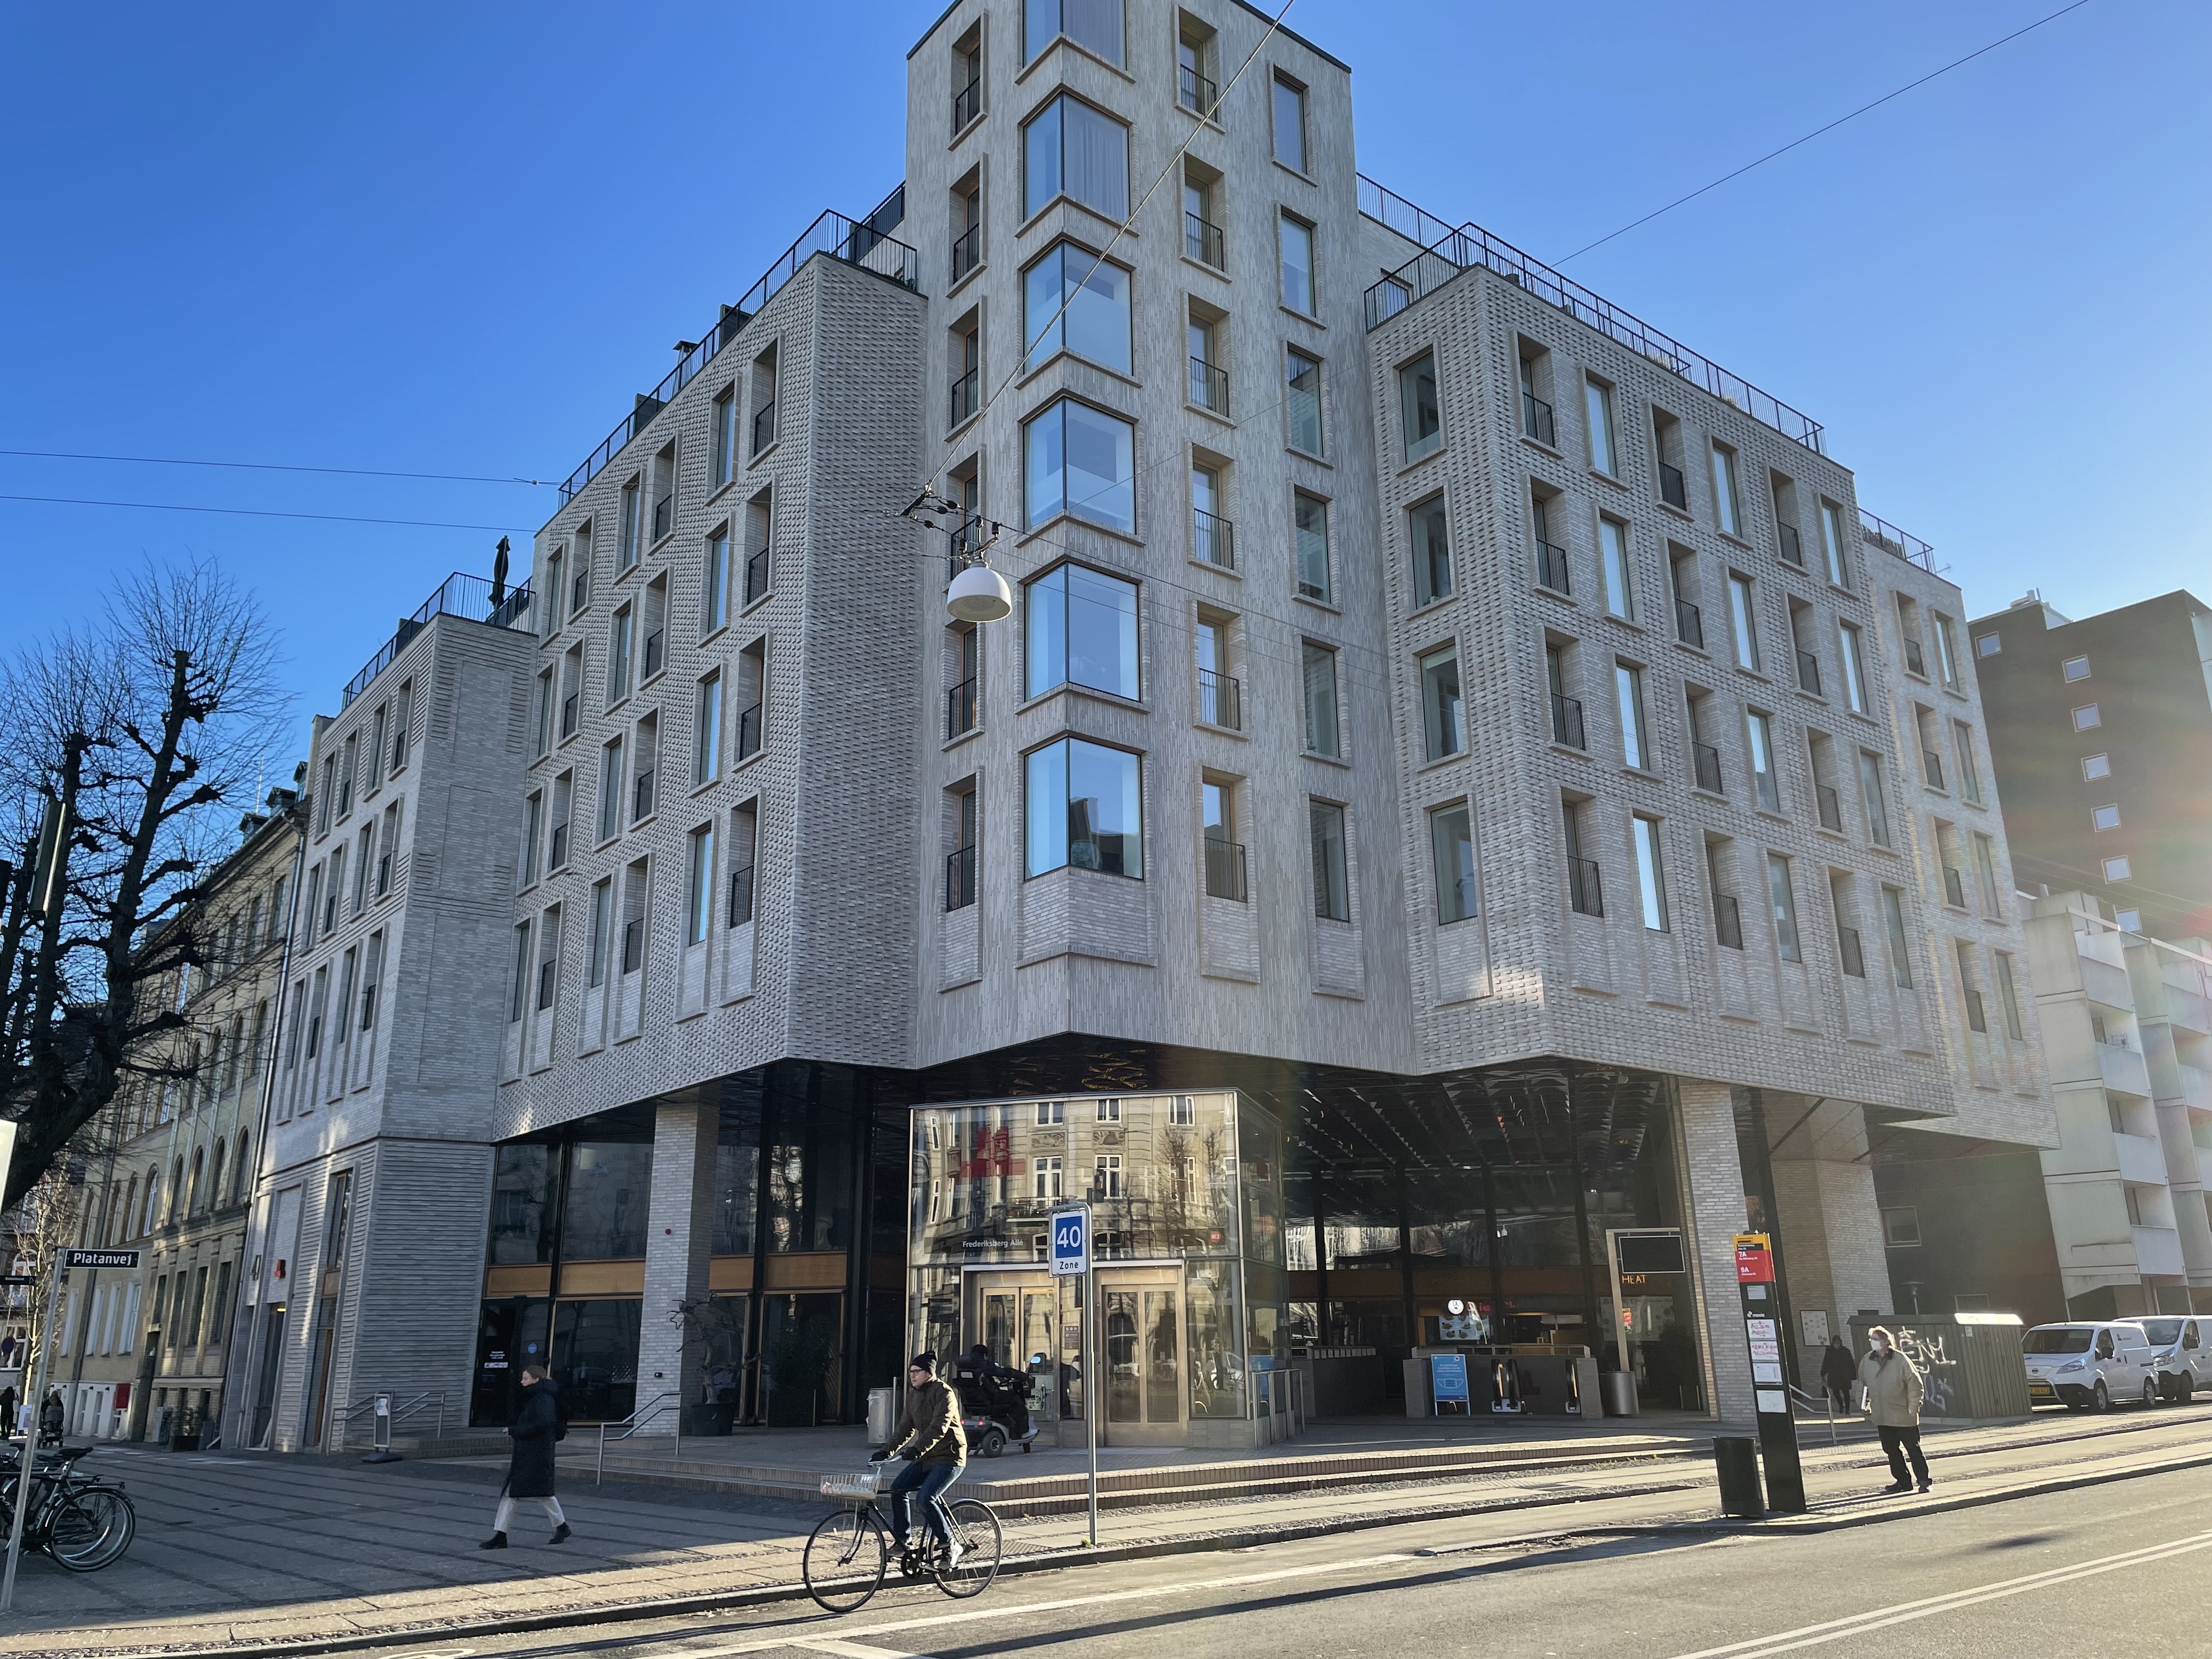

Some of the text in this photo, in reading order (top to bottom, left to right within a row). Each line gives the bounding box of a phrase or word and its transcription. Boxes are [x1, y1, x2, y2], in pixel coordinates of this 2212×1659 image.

[1057, 1226, 1081, 1248] 40
[962, 1240, 1008, 1248] Frederiksberg
[73, 1252, 132, 1266] Platanvej
[1059, 1261, 1079, 1270] Zone
[1622, 1274, 1646, 1284] HEAT
